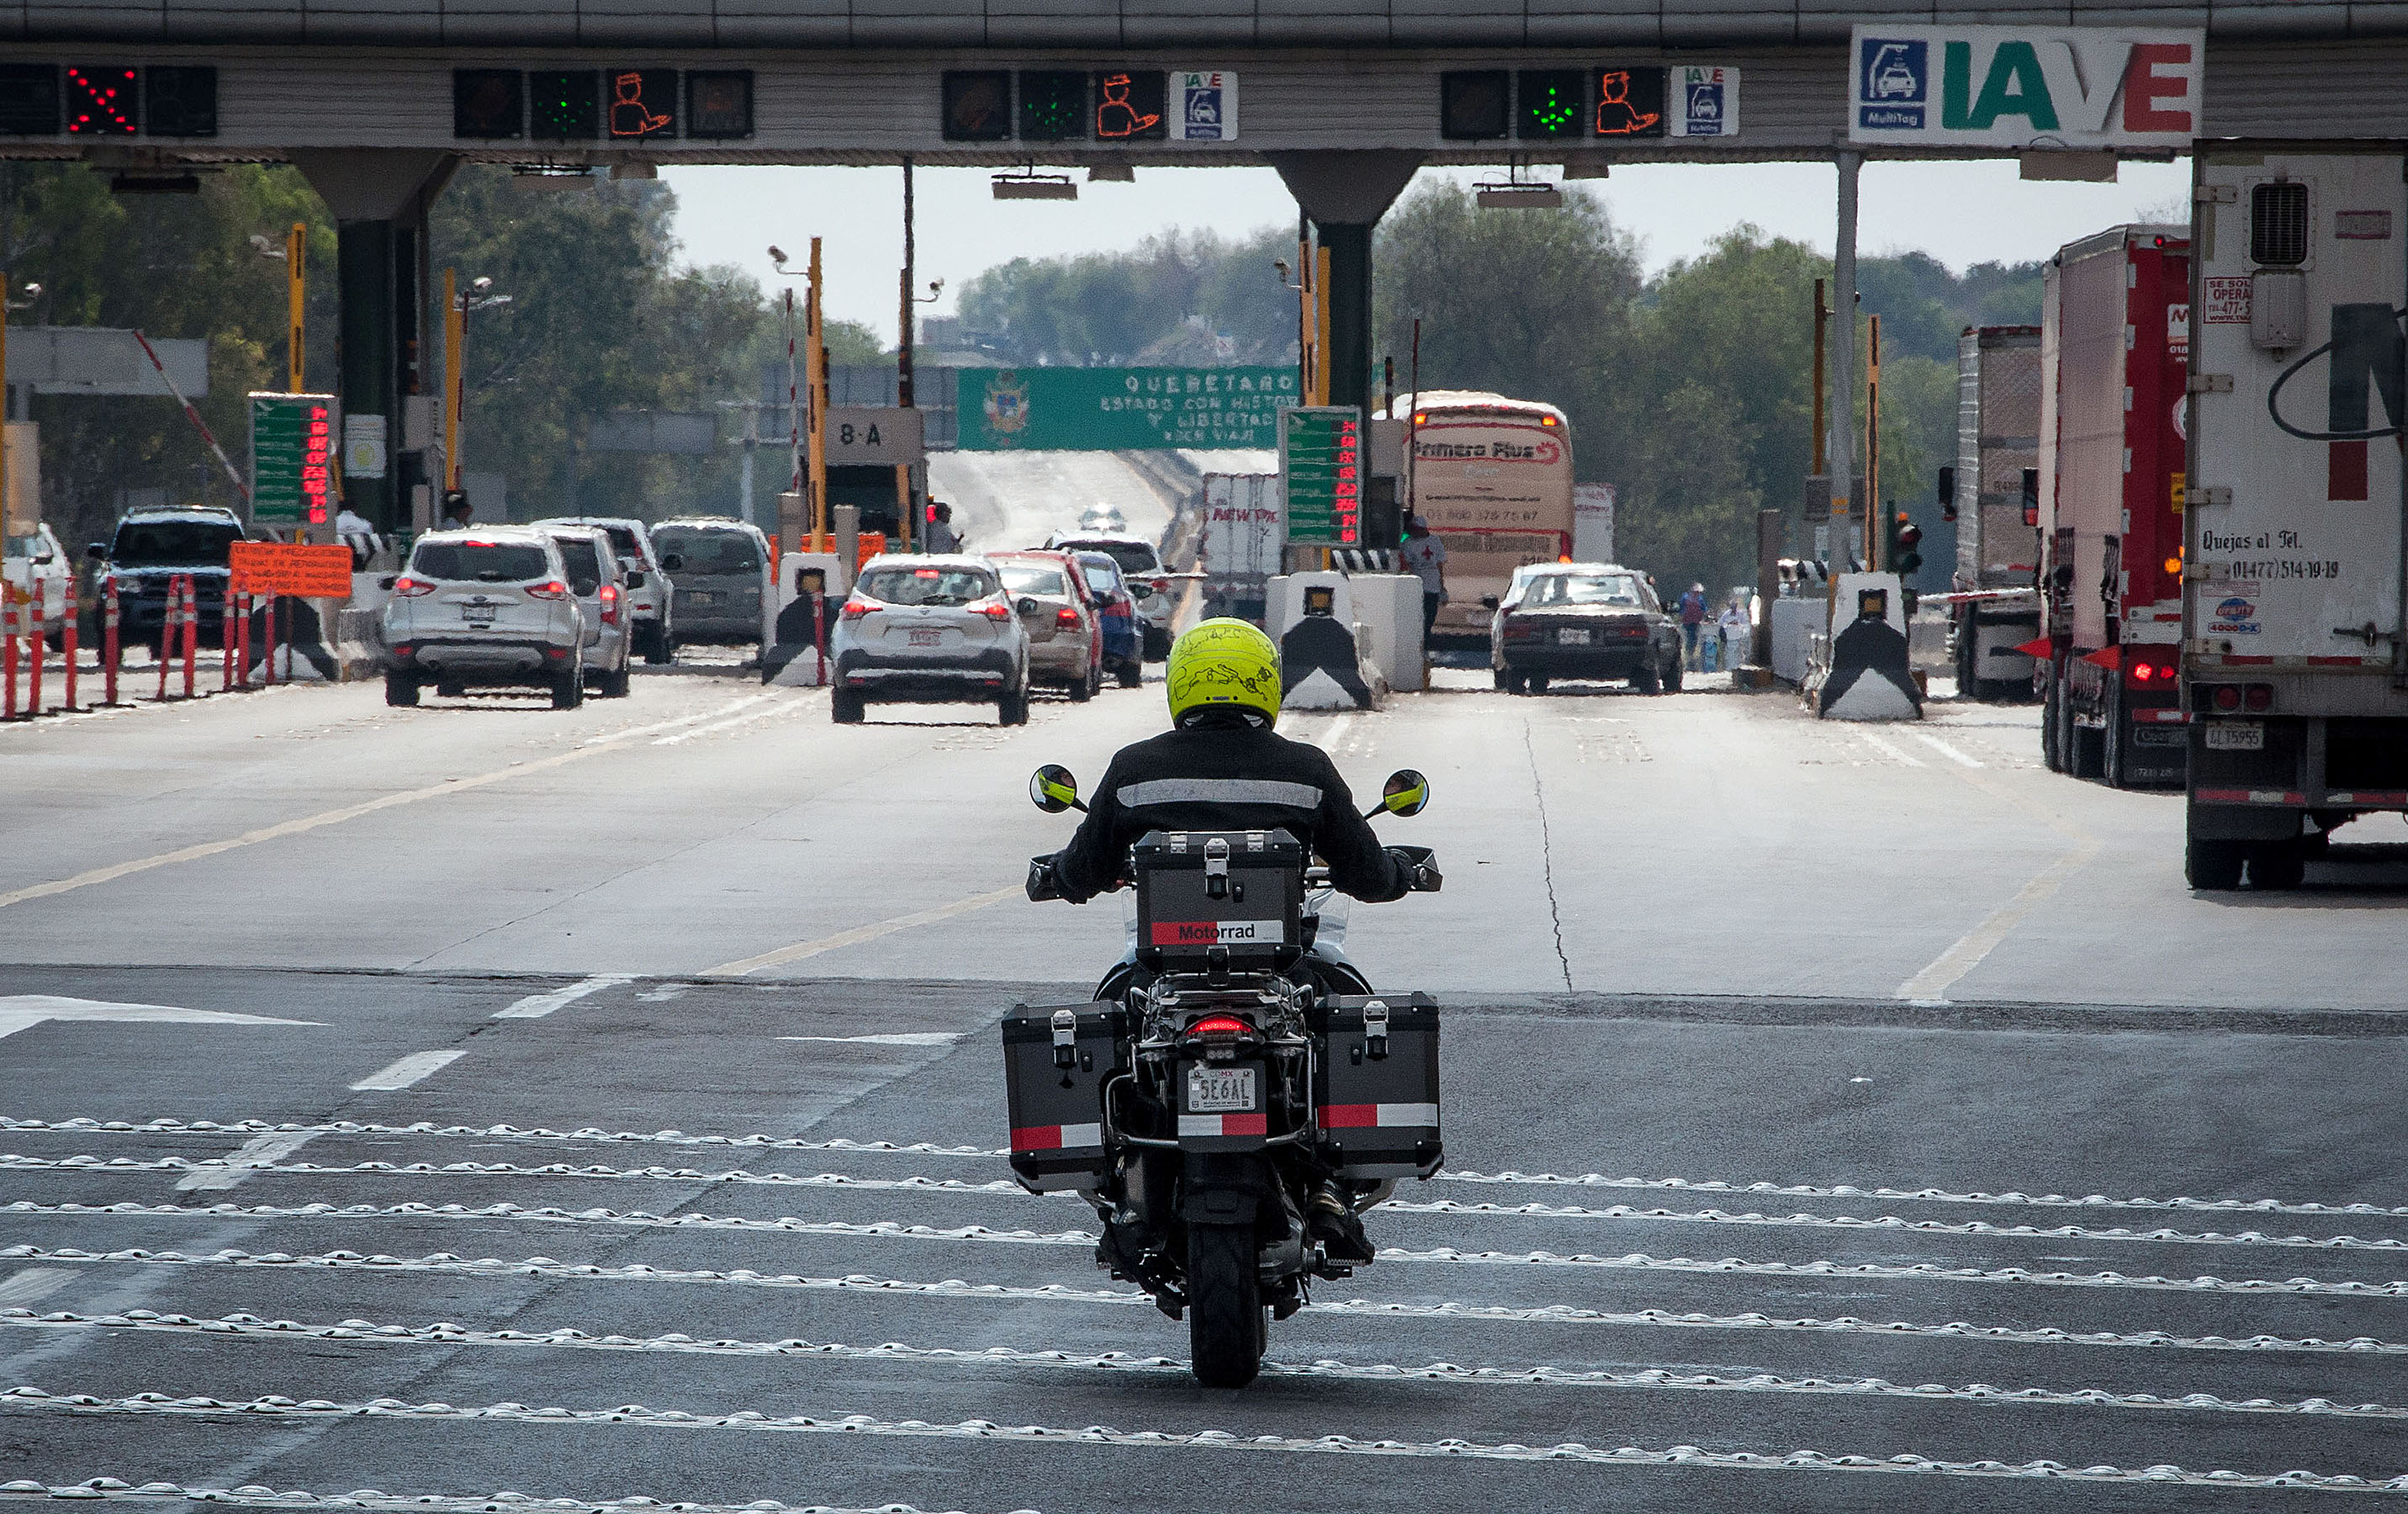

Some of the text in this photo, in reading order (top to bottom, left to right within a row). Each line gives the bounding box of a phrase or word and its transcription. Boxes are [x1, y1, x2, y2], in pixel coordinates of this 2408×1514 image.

[1686, 67, 1724, 82] IAVE
[1943, 40, 2192, 133] IAVE
[1868, 112, 1918, 126] MultiTag
[2213, 289, 2252, 300] OPERA
[1184, 397, 1222, 410] CON
[1492, 441, 1534, 458] Plus
[2203, 530, 2304, 553] Quejas al Tel.
[1179, 924, 1256, 940] Motorrad
